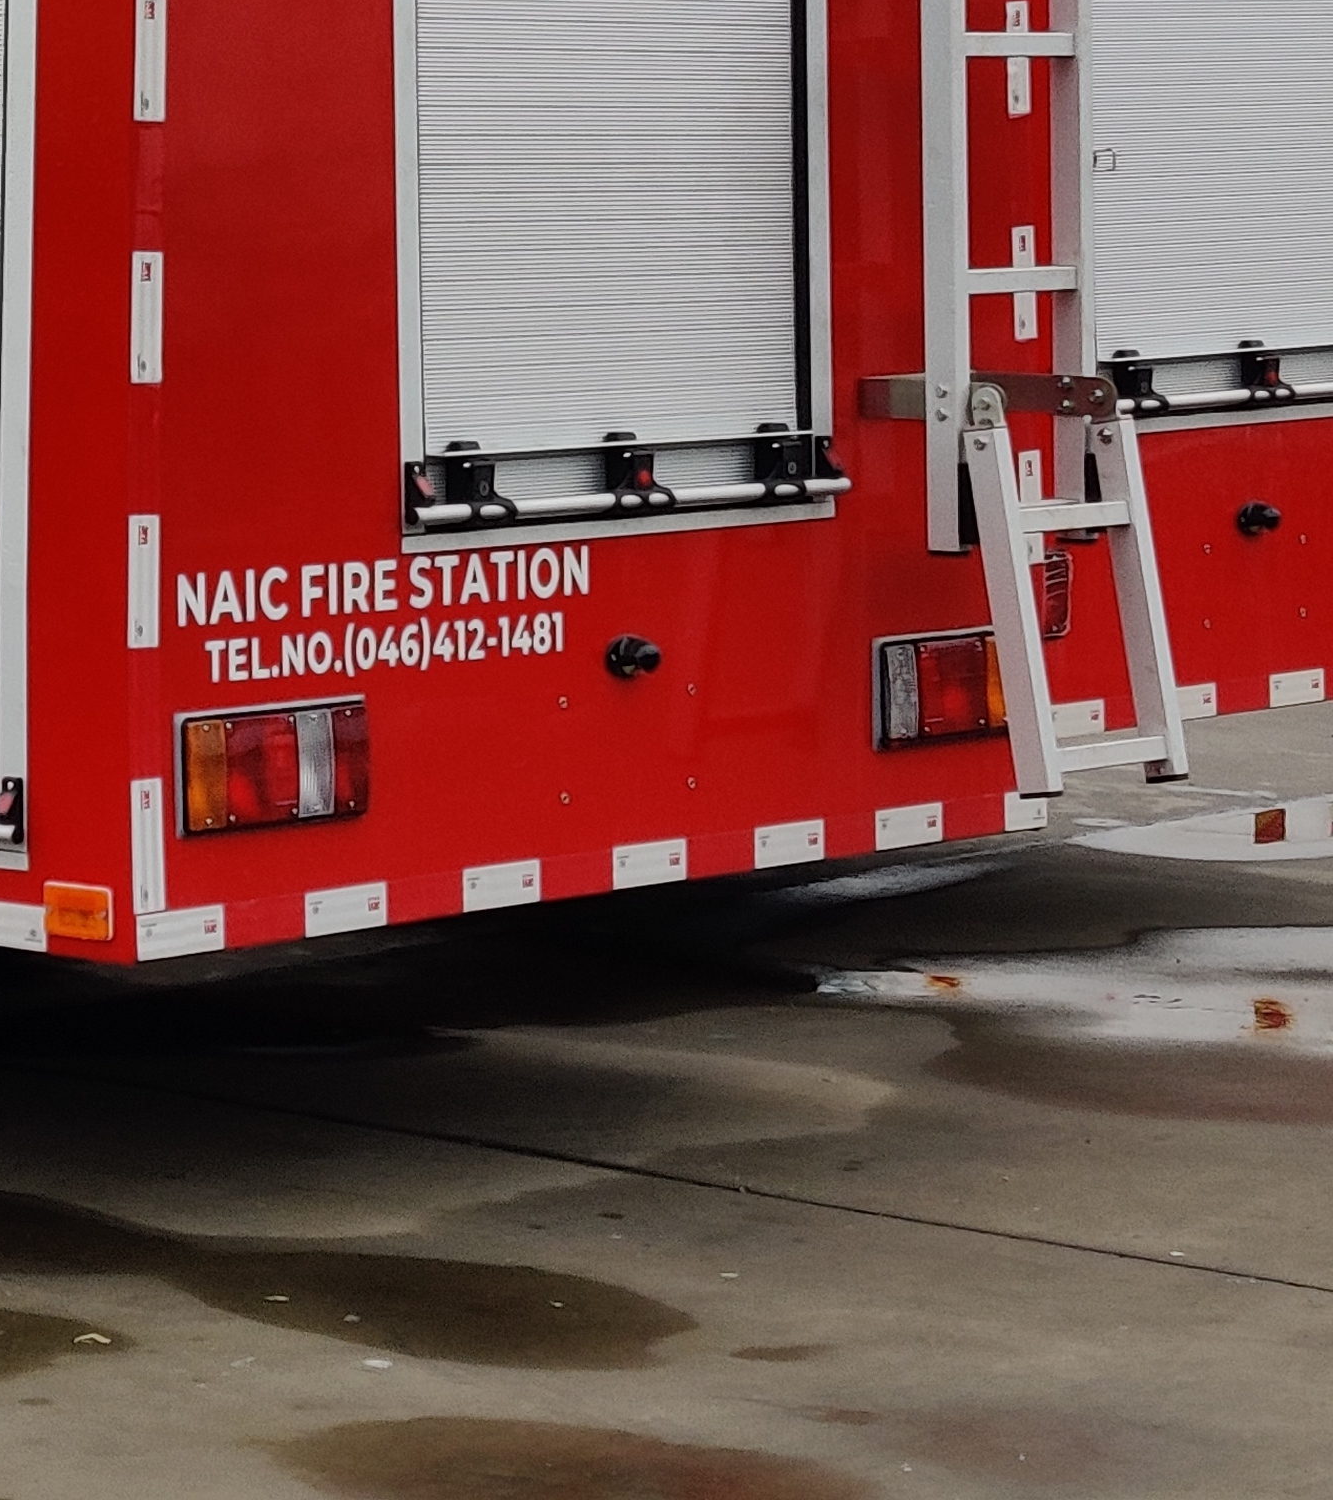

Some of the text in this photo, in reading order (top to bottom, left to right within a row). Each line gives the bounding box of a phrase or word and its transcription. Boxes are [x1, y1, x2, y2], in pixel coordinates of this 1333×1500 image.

[177, 546, 590, 628] NAIC FIRE STATION
[205, 611, 564, 683] TEL.NO.(046)412-1481
